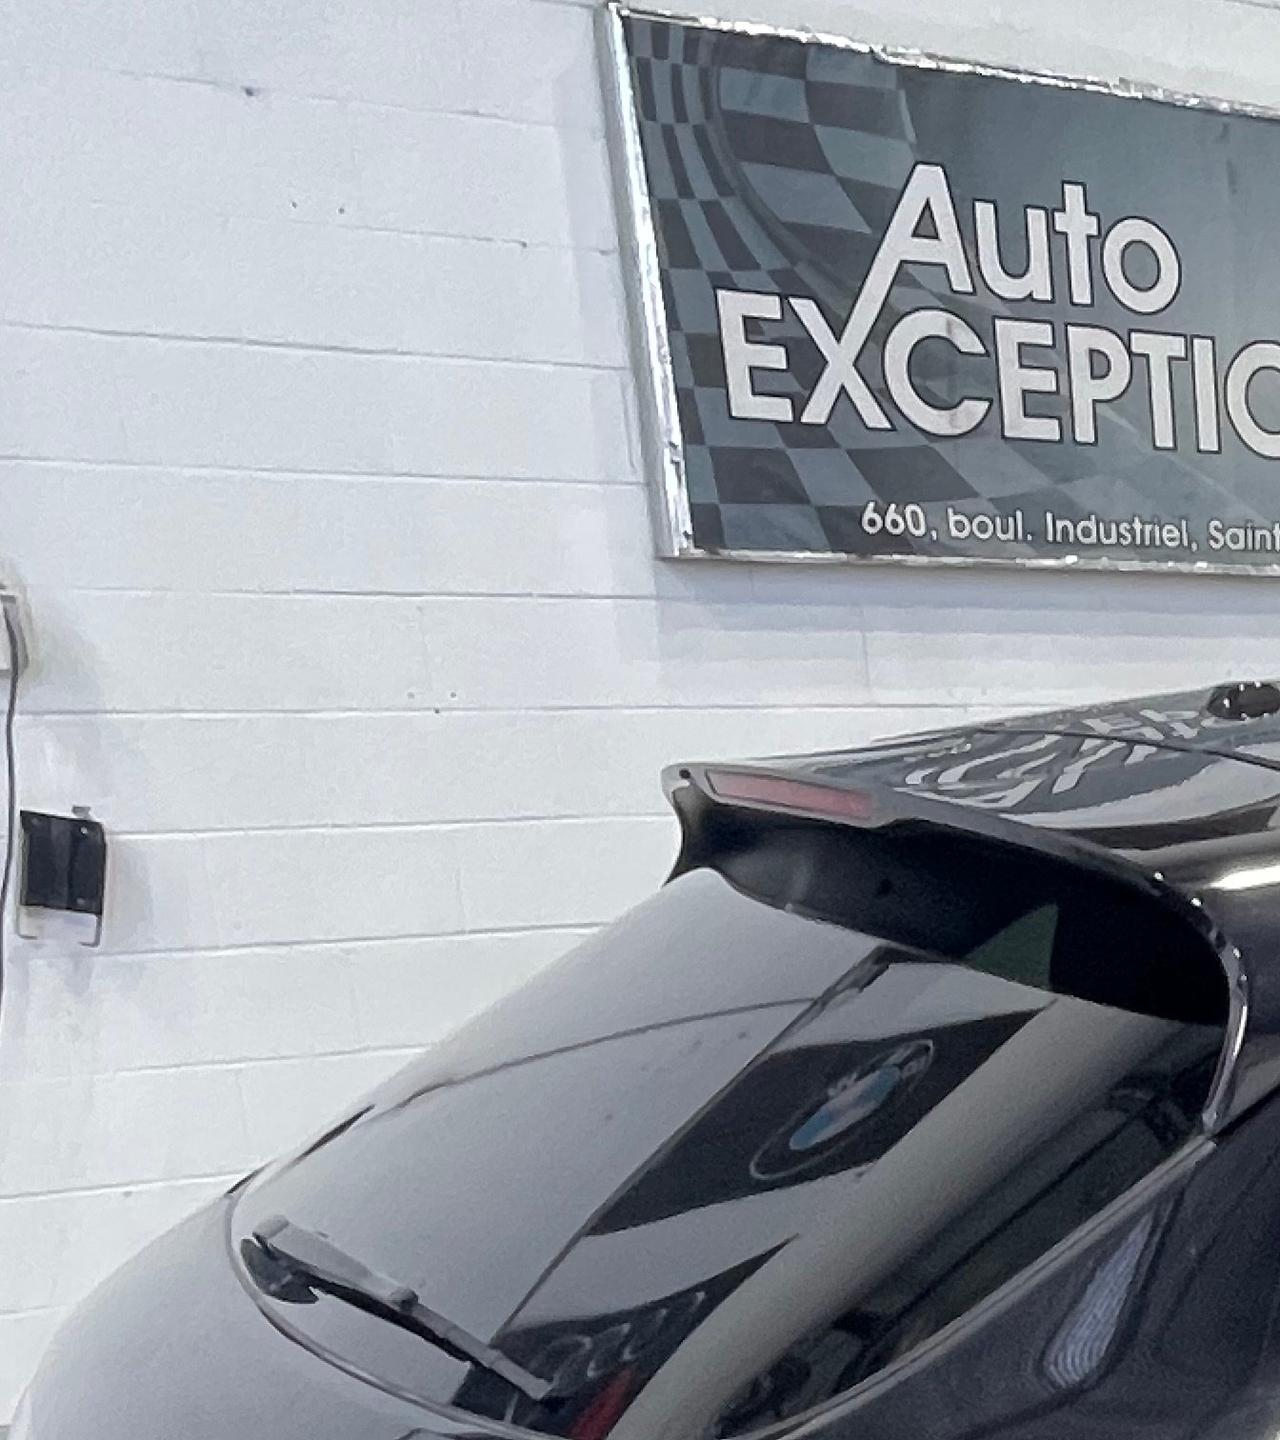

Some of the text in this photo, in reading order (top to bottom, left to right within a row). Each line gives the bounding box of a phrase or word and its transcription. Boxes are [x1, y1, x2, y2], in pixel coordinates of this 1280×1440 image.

[870, 163, 1180, 314] Auto
[860, 500, 938, 541] 660,
[946, 506, 1033, 542] boul.
[1045, 510, 1198, 553] Industriel,
